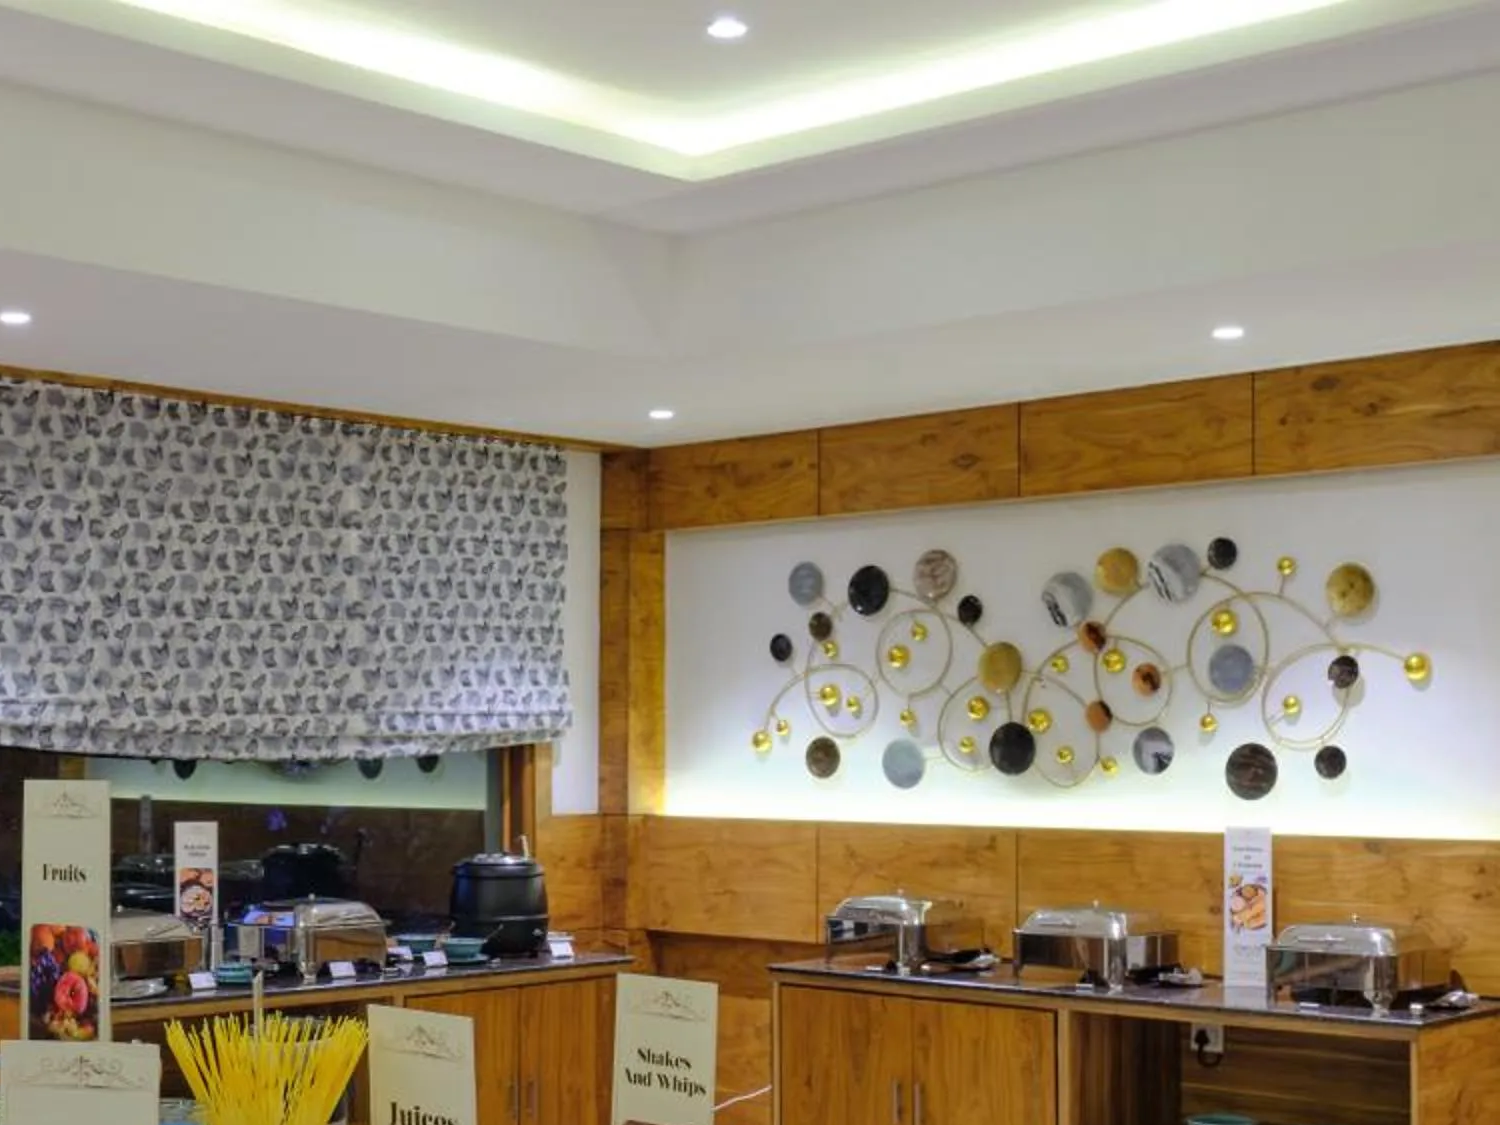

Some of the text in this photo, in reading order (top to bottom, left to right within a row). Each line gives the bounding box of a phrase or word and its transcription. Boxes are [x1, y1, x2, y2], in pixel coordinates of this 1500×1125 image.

[42, 863, 87, 883] Fruits
[637, 1048, 691, 1069] Shakes
[625, 1068, 706, 1098] And Whips
